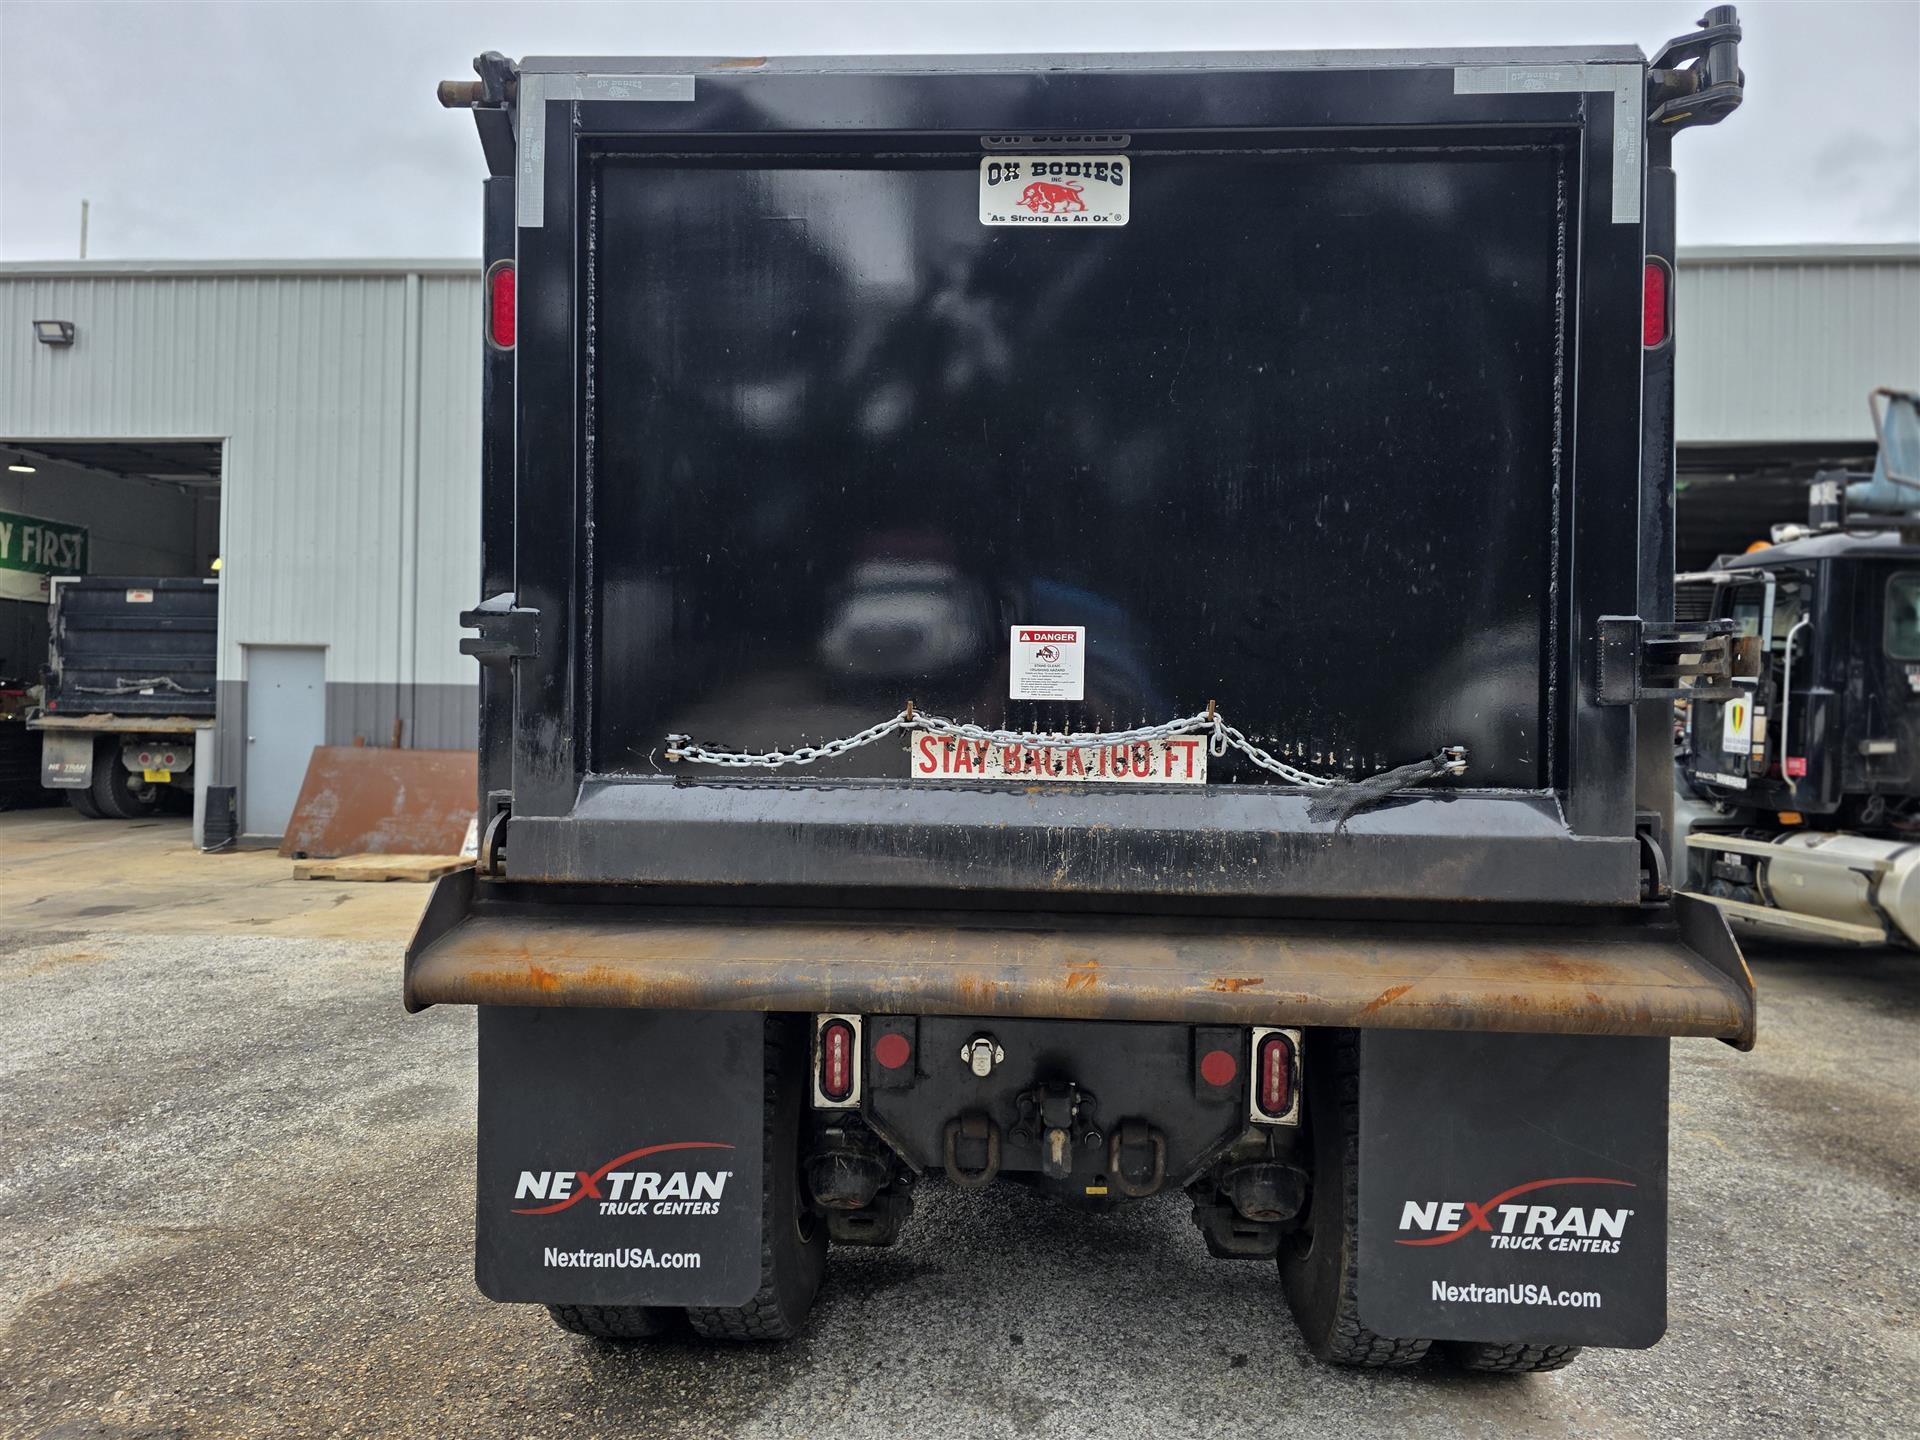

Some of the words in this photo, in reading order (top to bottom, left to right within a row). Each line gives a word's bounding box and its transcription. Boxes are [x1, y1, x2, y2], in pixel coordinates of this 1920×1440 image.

[987, 162, 1021, 186] OX
[1031, 162, 1124, 186] BODIES
[1011, 215, 1050, 224] Strong
[1054, 215, 1069, 223] As
[1074, 215, 1089, 223] An
[22, 525, 82, 570] FIRST
[1034, 633, 1075, 641] DANGER
[918, 735, 990, 774] STAY
[1003, 738, 1085, 777] BACK
[1099, 740, 1151, 778] 100
[1165, 741, 1199, 778] FT
[514, 1171, 729, 1201] NEXTRAN
[599, 1201, 649, 1216] TRUCK
[653, 1201, 721, 1216] CENTERS
[1398, 1201, 1629, 1238] NEXTRAN
[1490, 1235, 1544, 1251] TRUCK
[1548, 1236, 1621, 1254] CENTERS
[543, 1247, 701, 1269] NextranUSA.com
[1431, 1280, 1602, 1308] NextranUSA.com
